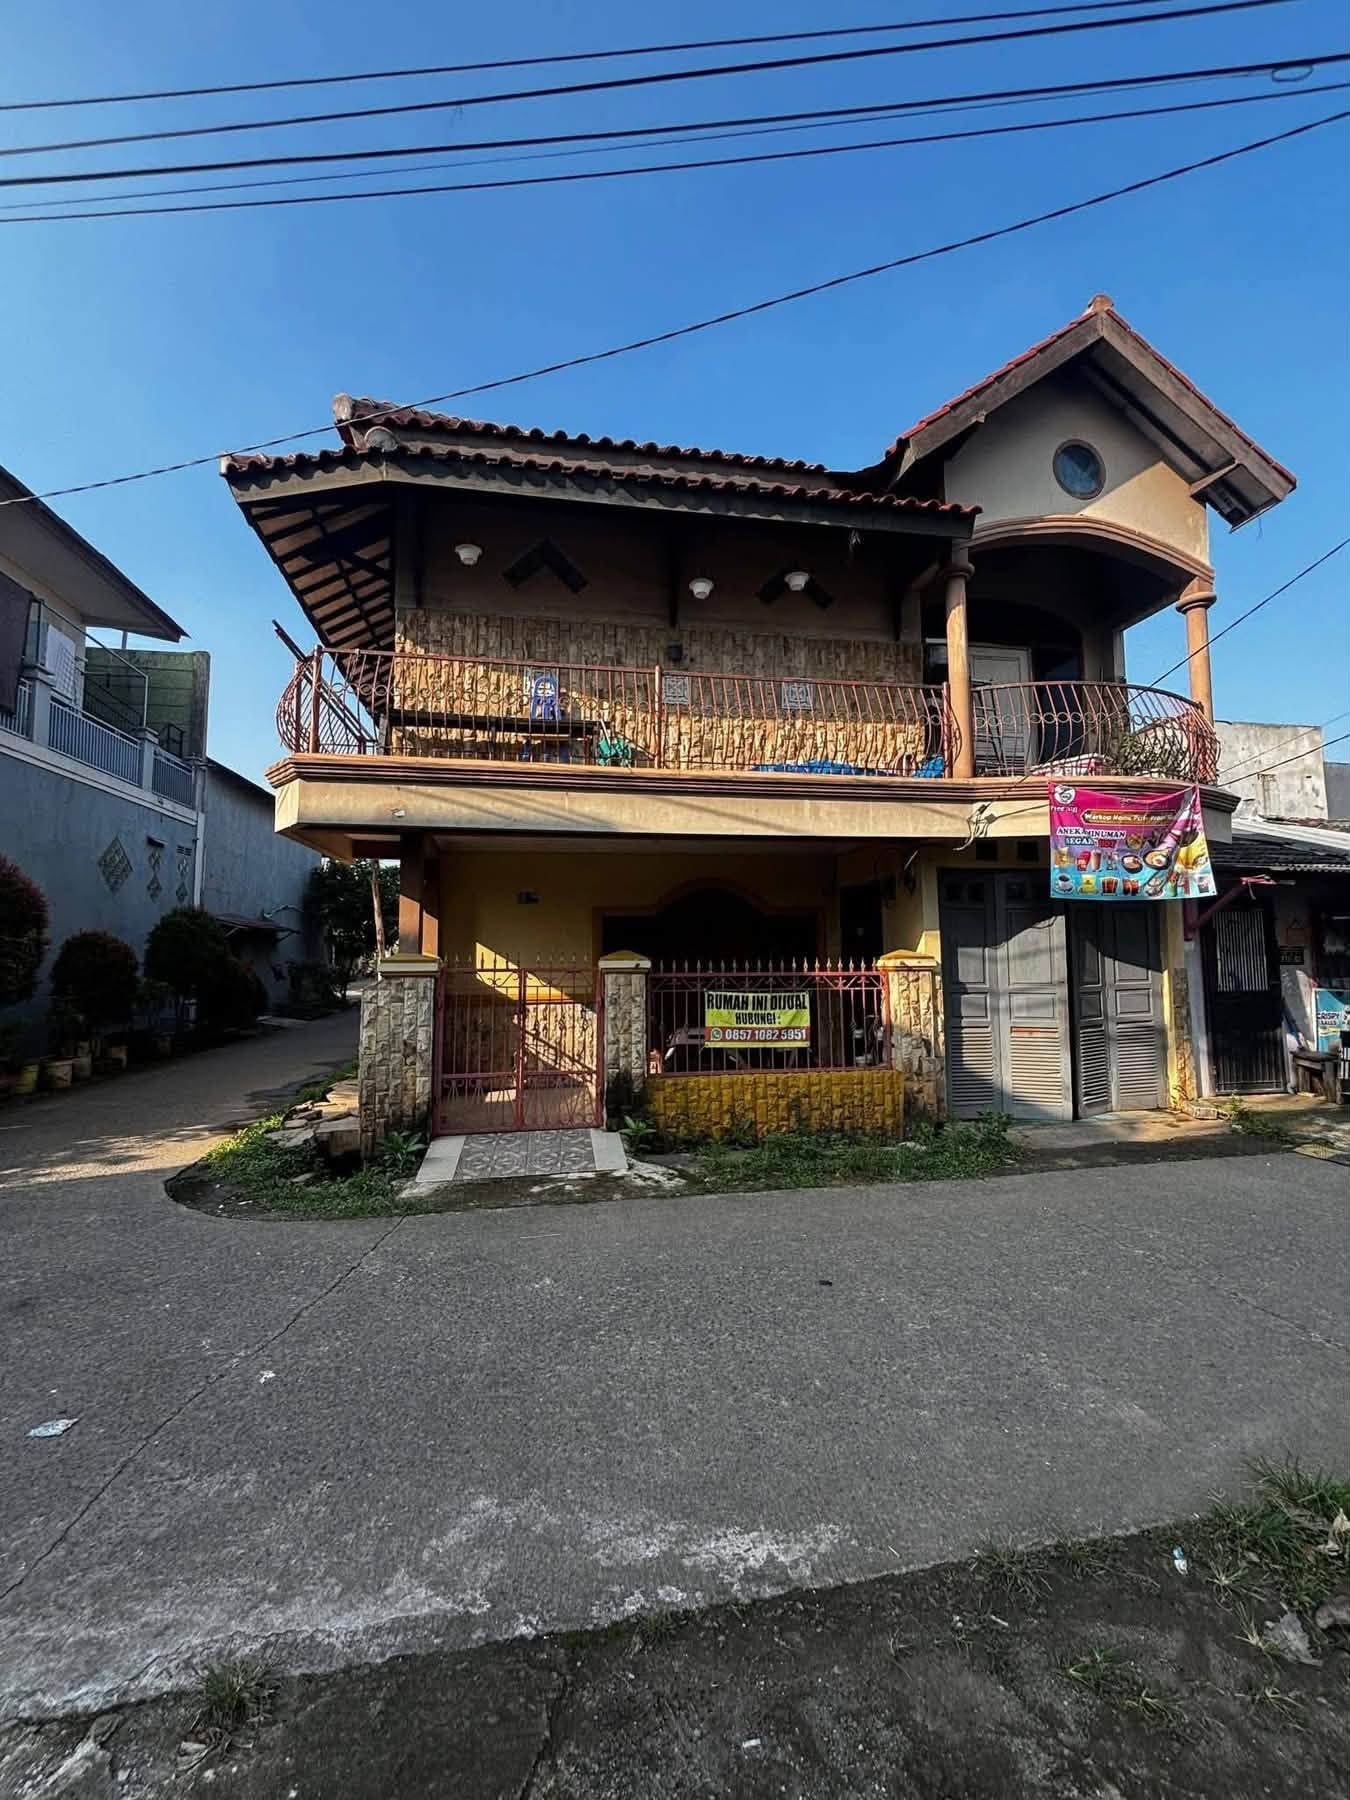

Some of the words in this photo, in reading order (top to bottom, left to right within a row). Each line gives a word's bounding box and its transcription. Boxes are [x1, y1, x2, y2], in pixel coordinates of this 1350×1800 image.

[707, 993, 749, 1010] RUMAH
[752, 995, 769, 1010] INI
[770, 995, 807, 1010] DIJUAL
[735, 1012, 777, 1025] HUBUNGI
[725, 1029, 752, 1041] 0857
[755, 1029, 779, 1041] 1082
[780, 1029, 807, 1041] 5951
